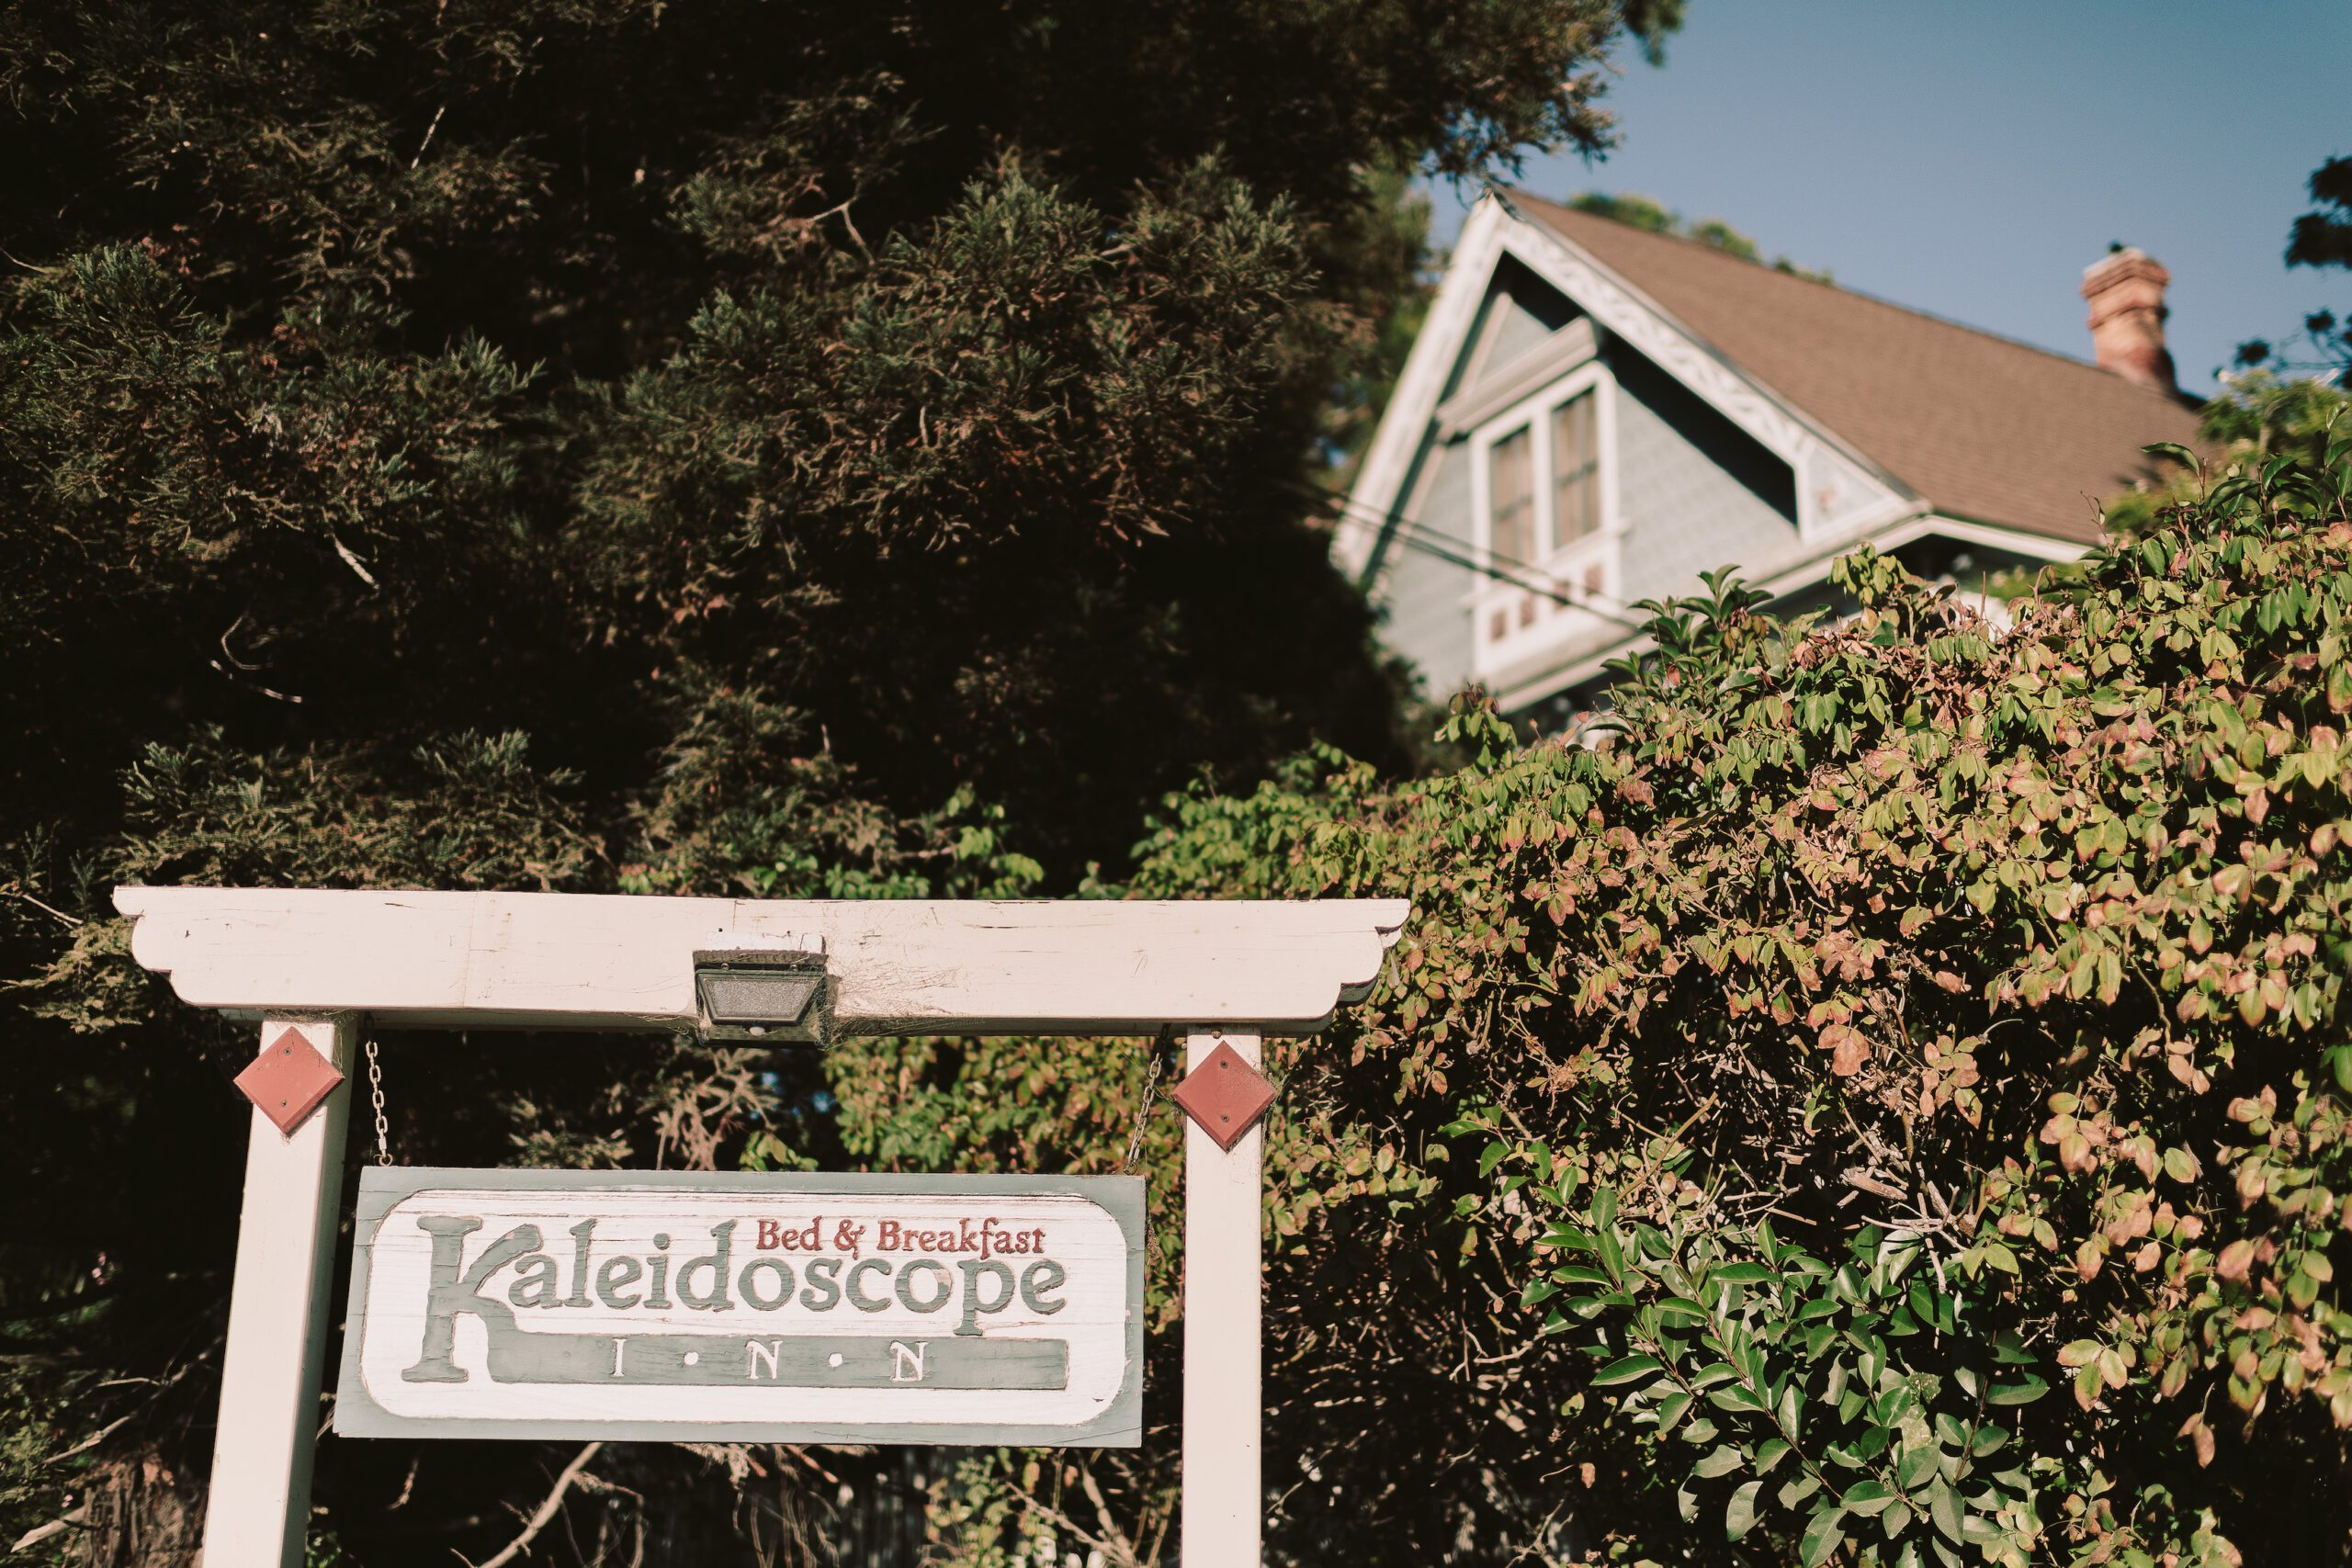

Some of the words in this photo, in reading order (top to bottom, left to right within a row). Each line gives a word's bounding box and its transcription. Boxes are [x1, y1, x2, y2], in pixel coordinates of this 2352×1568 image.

[755, 1215, 823, 1252] Bed
[833, 1218, 865, 1260] &
[876, 1217, 1046, 1260] Breakfast
[401, 1215, 1069, 1382] Kaleidoscope
